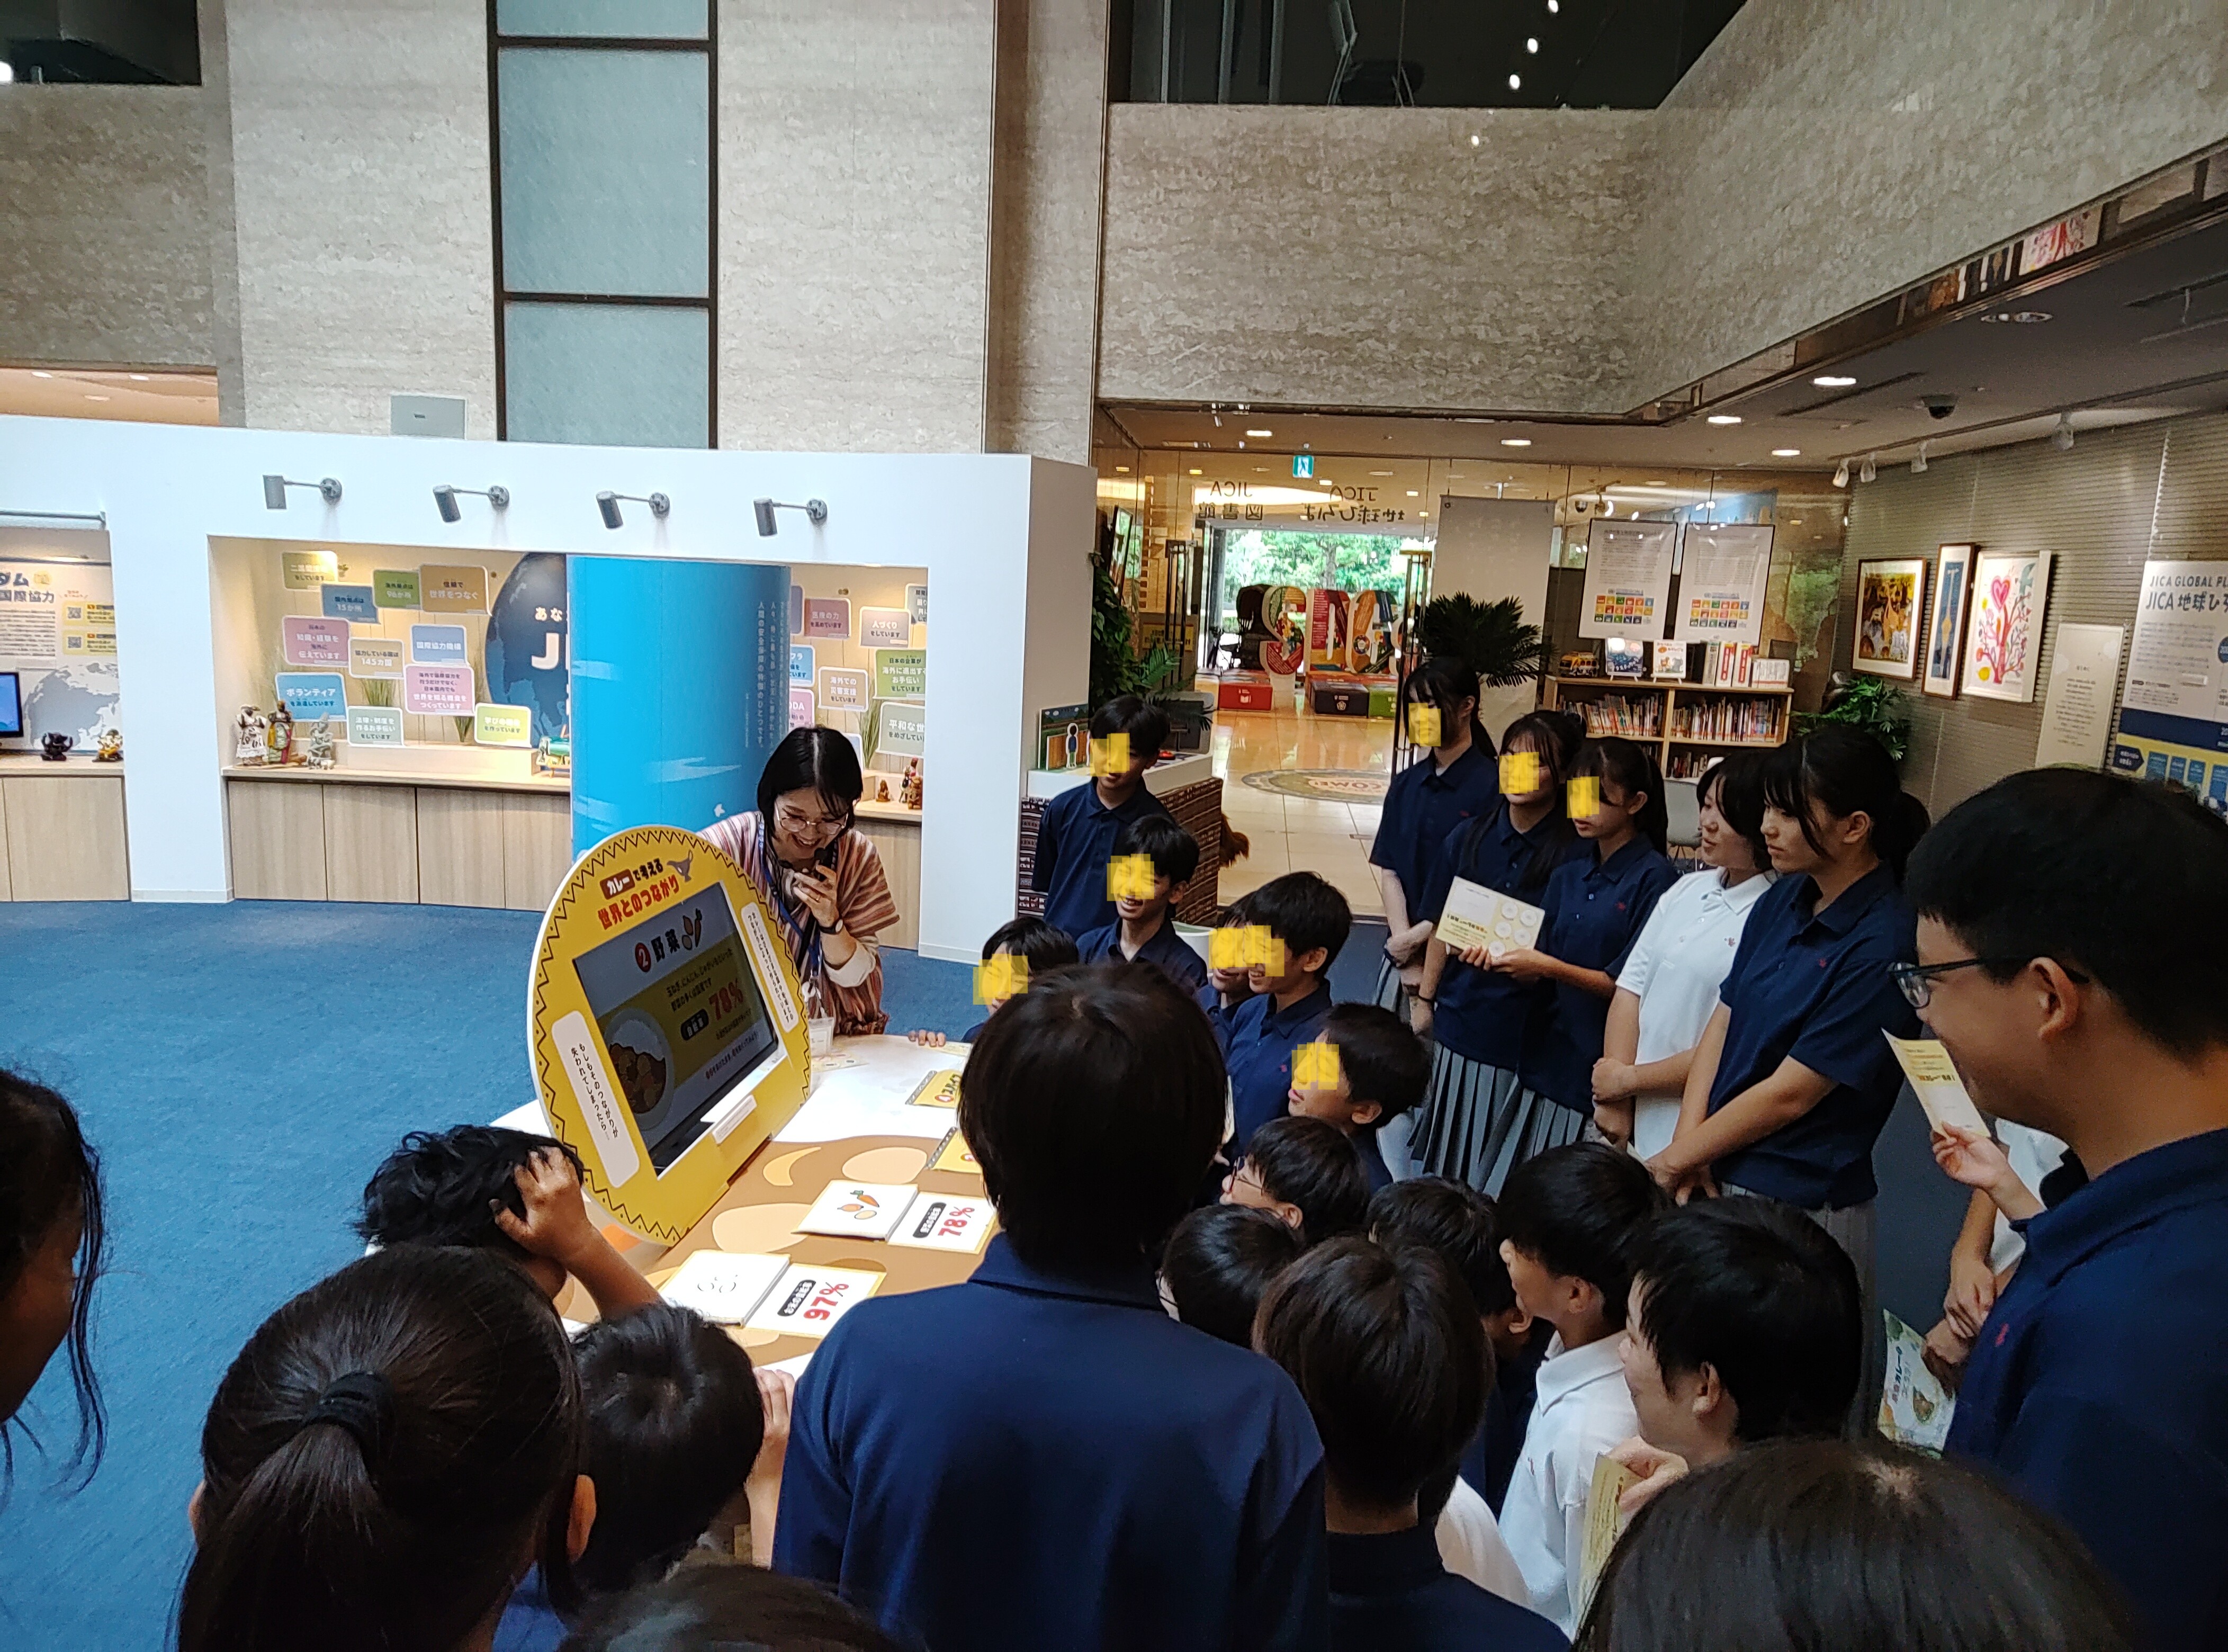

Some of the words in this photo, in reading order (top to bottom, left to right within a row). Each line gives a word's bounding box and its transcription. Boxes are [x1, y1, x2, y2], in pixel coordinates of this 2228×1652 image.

[2150, 576, 2171, 587] JICA
[2175, 576, 2212, 587] GLOBAL
[429, 590, 478, 599] 世界をつなぐ
[2146, 591, 2173, 610] JICA
[535, 607, 568, 622] あな
[812, 611, 839, 620] 医療の力
[872, 621, 897, 629] 人づくり
[416, 642, 462, 650] 国際協力機構
[298, 651, 339, 659] 伝えています
[830, 676, 856, 685] 海外での
[286, 688, 336, 697] ボランティア
[830, 687, 856, 696] 災害支援
[889, 719, 924, 733] 平和な世
[889, 732, 924, 741] をめざしてい
[597, 874, 680, 930] 世界とのつながり
[651, 929, 680, 963] 野菜
[708, 978, 744, 1021] 78%
[579, 1043, 618, 1138] もしもそのつながりが
[937, 1206, 975, 1236] 78%
[803, 1282, 849, 1321] 97%
